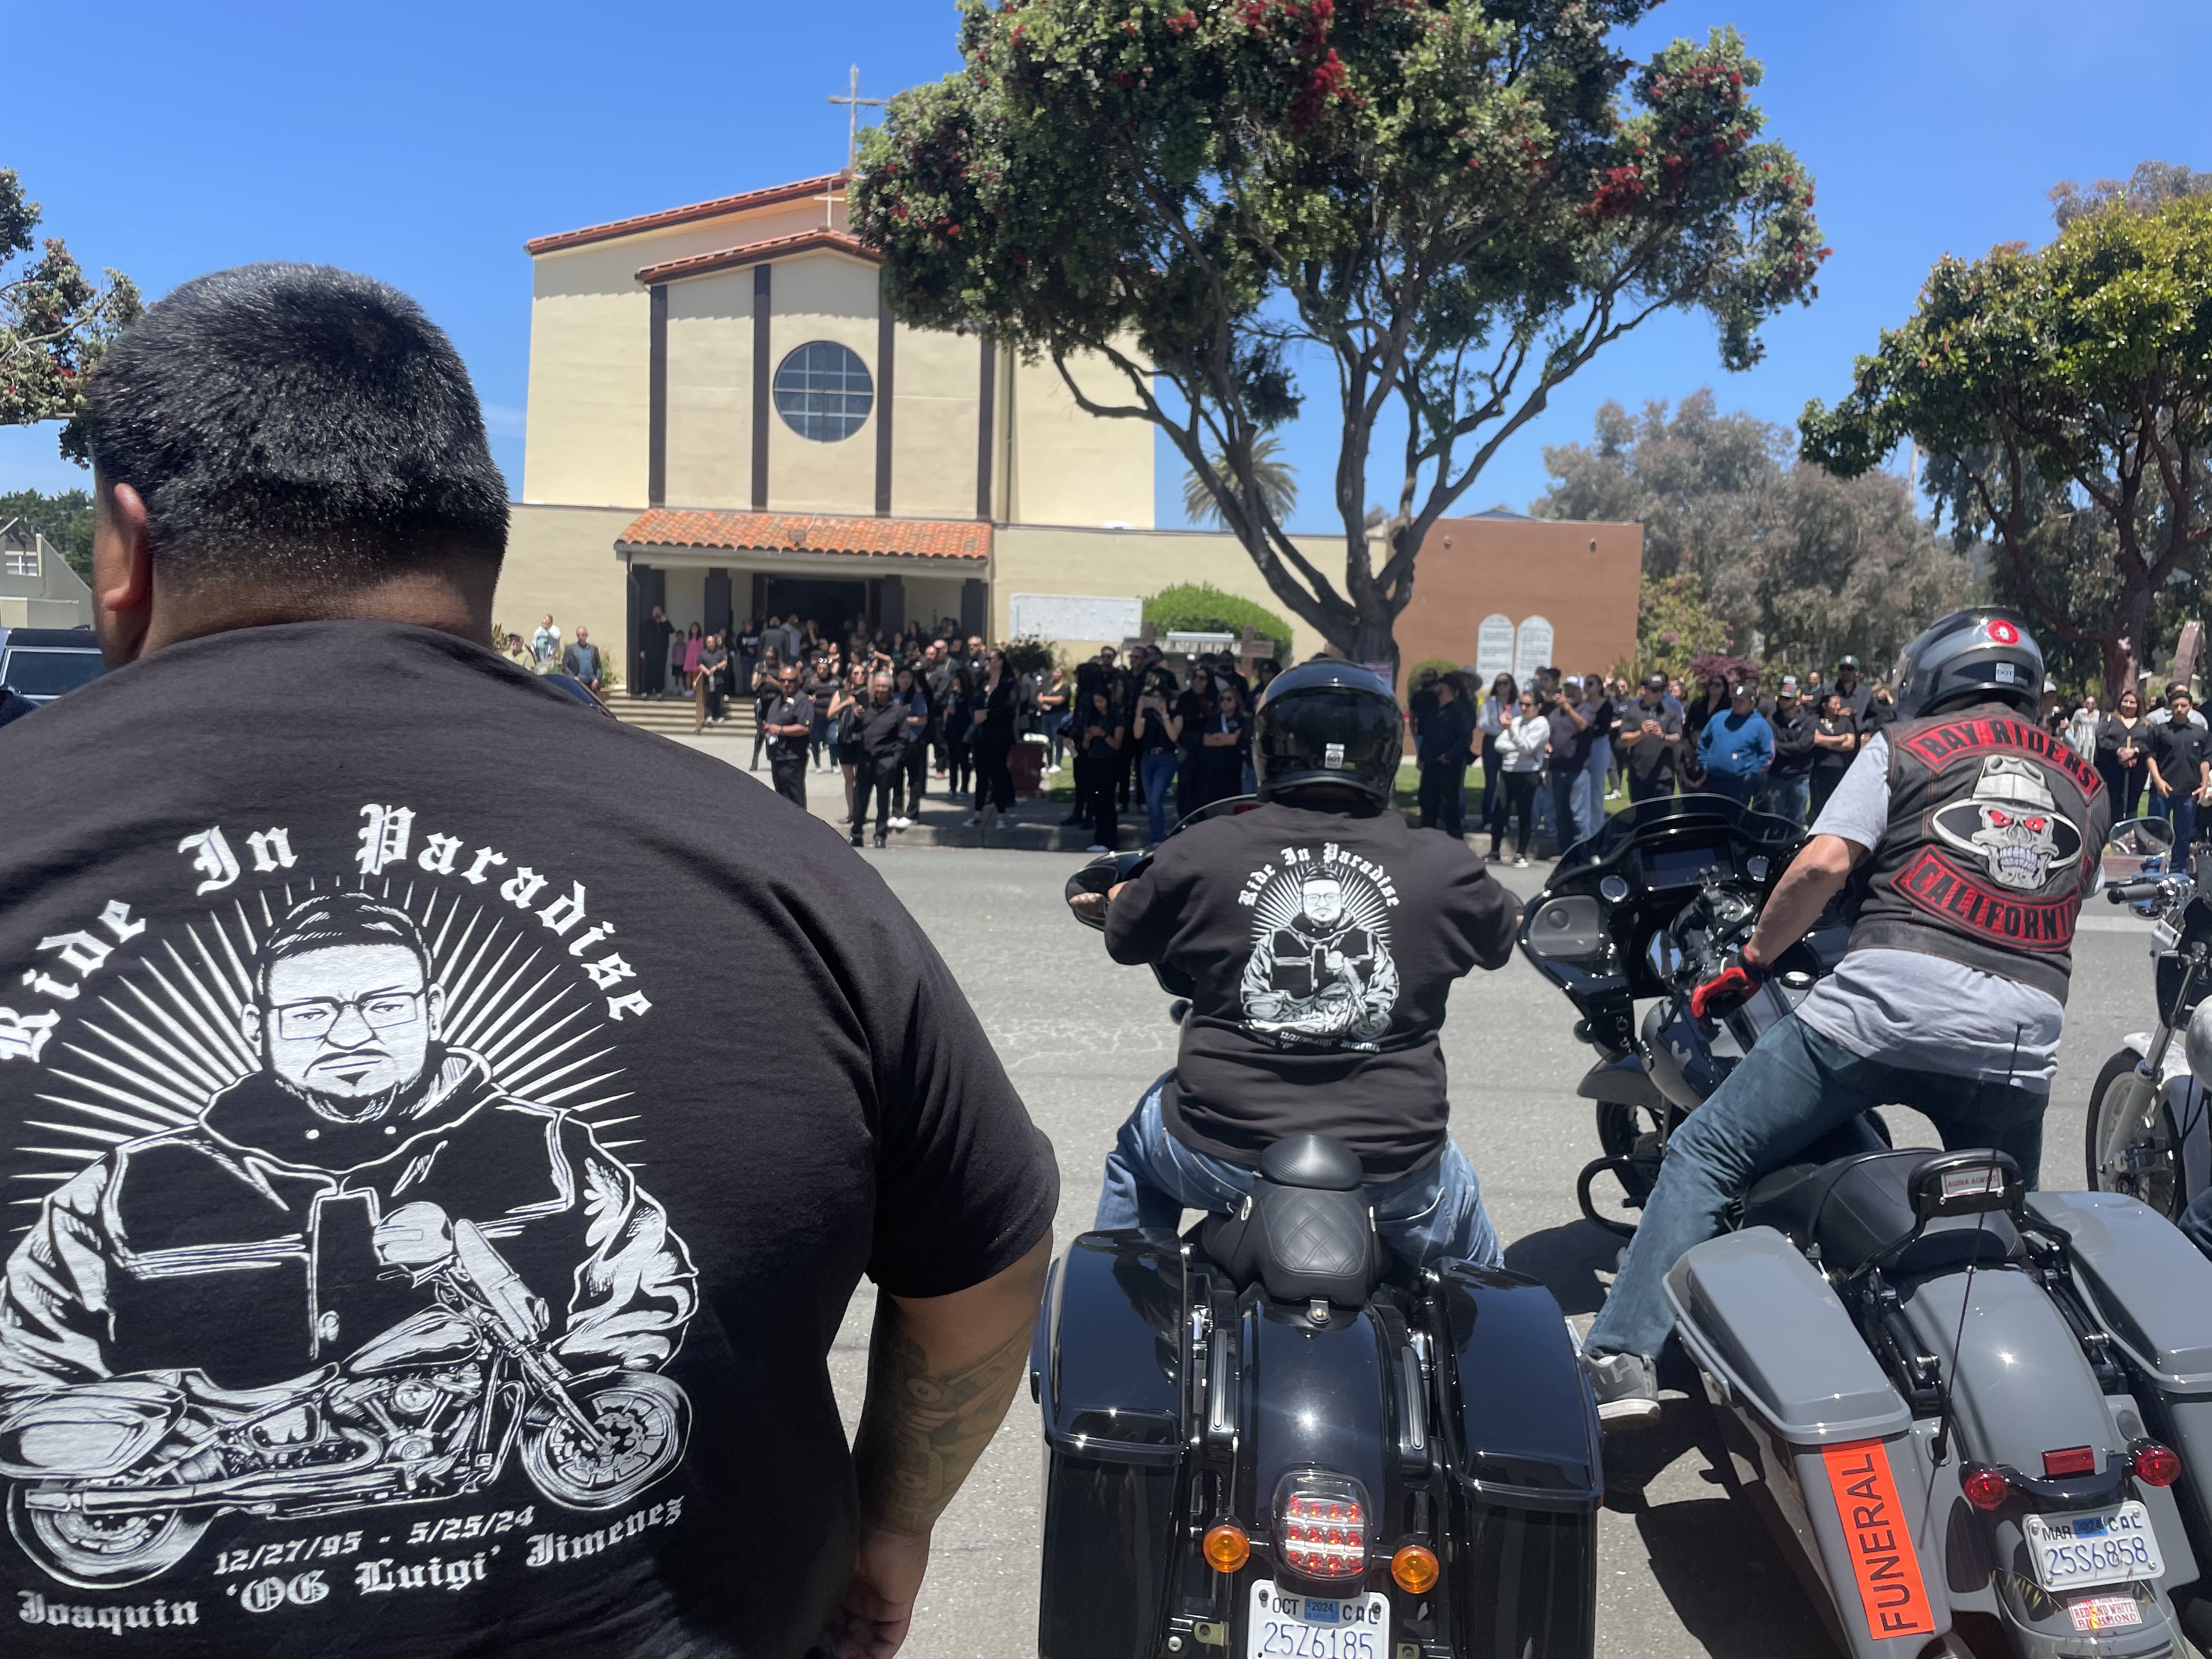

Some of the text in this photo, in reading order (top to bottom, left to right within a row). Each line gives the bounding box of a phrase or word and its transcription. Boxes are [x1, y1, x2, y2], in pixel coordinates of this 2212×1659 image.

[1918, 723, 1979, 759] BAY
[1238, 842, 1401, 907] Ride In Paradise
[0, 803, 653, 1063] Ride In Paradise
[1971, 1175, 1996, 1184] ALWS
[214, 1530, 364, 1575] 12/27/95
[407, 1505, 535, 1544] 5/25/24
[1841, 1453, 1918, 1632] FUNERAL
[2041, 1525, 2073, 1542] MAR
[2108, 1515, 2143, 1532] CAL
[19, 1590, 200, 1636] Joaquin
[526, 1495, 685, 1567] Jimenez
[2045, 1536, 2149, 1576] 25S6858
[1272, 1597, 1378, 1625] OCT 2024 CAL
[2074, 1607, 2090, 1619] RED
[2091, 1604, 2108, 1617] ND
[2108, 1602, 2136, 1615] WHITE
[2078, 1613, 2137, 1628] RIHMOND
[1264, 1621, 1373, 1659] 25Z6185
